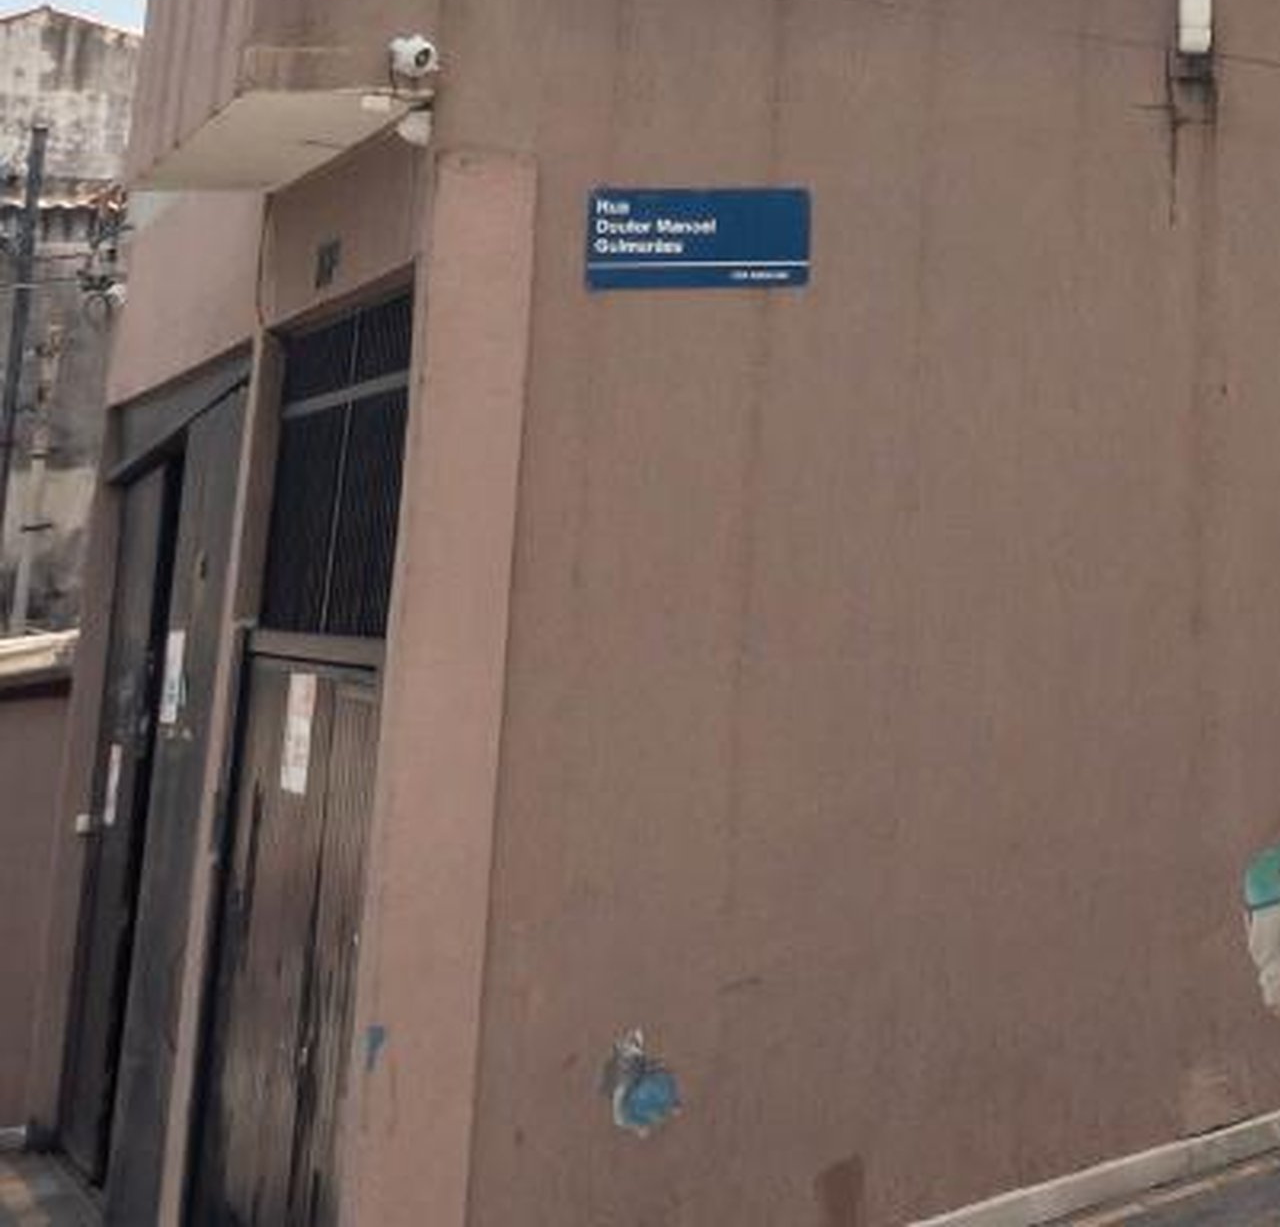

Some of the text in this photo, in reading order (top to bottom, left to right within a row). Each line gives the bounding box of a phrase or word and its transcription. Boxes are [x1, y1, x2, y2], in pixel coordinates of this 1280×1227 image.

[596, 199, 630, 215] Rua
[596, 218, 717, 234] Doutor Manoel
